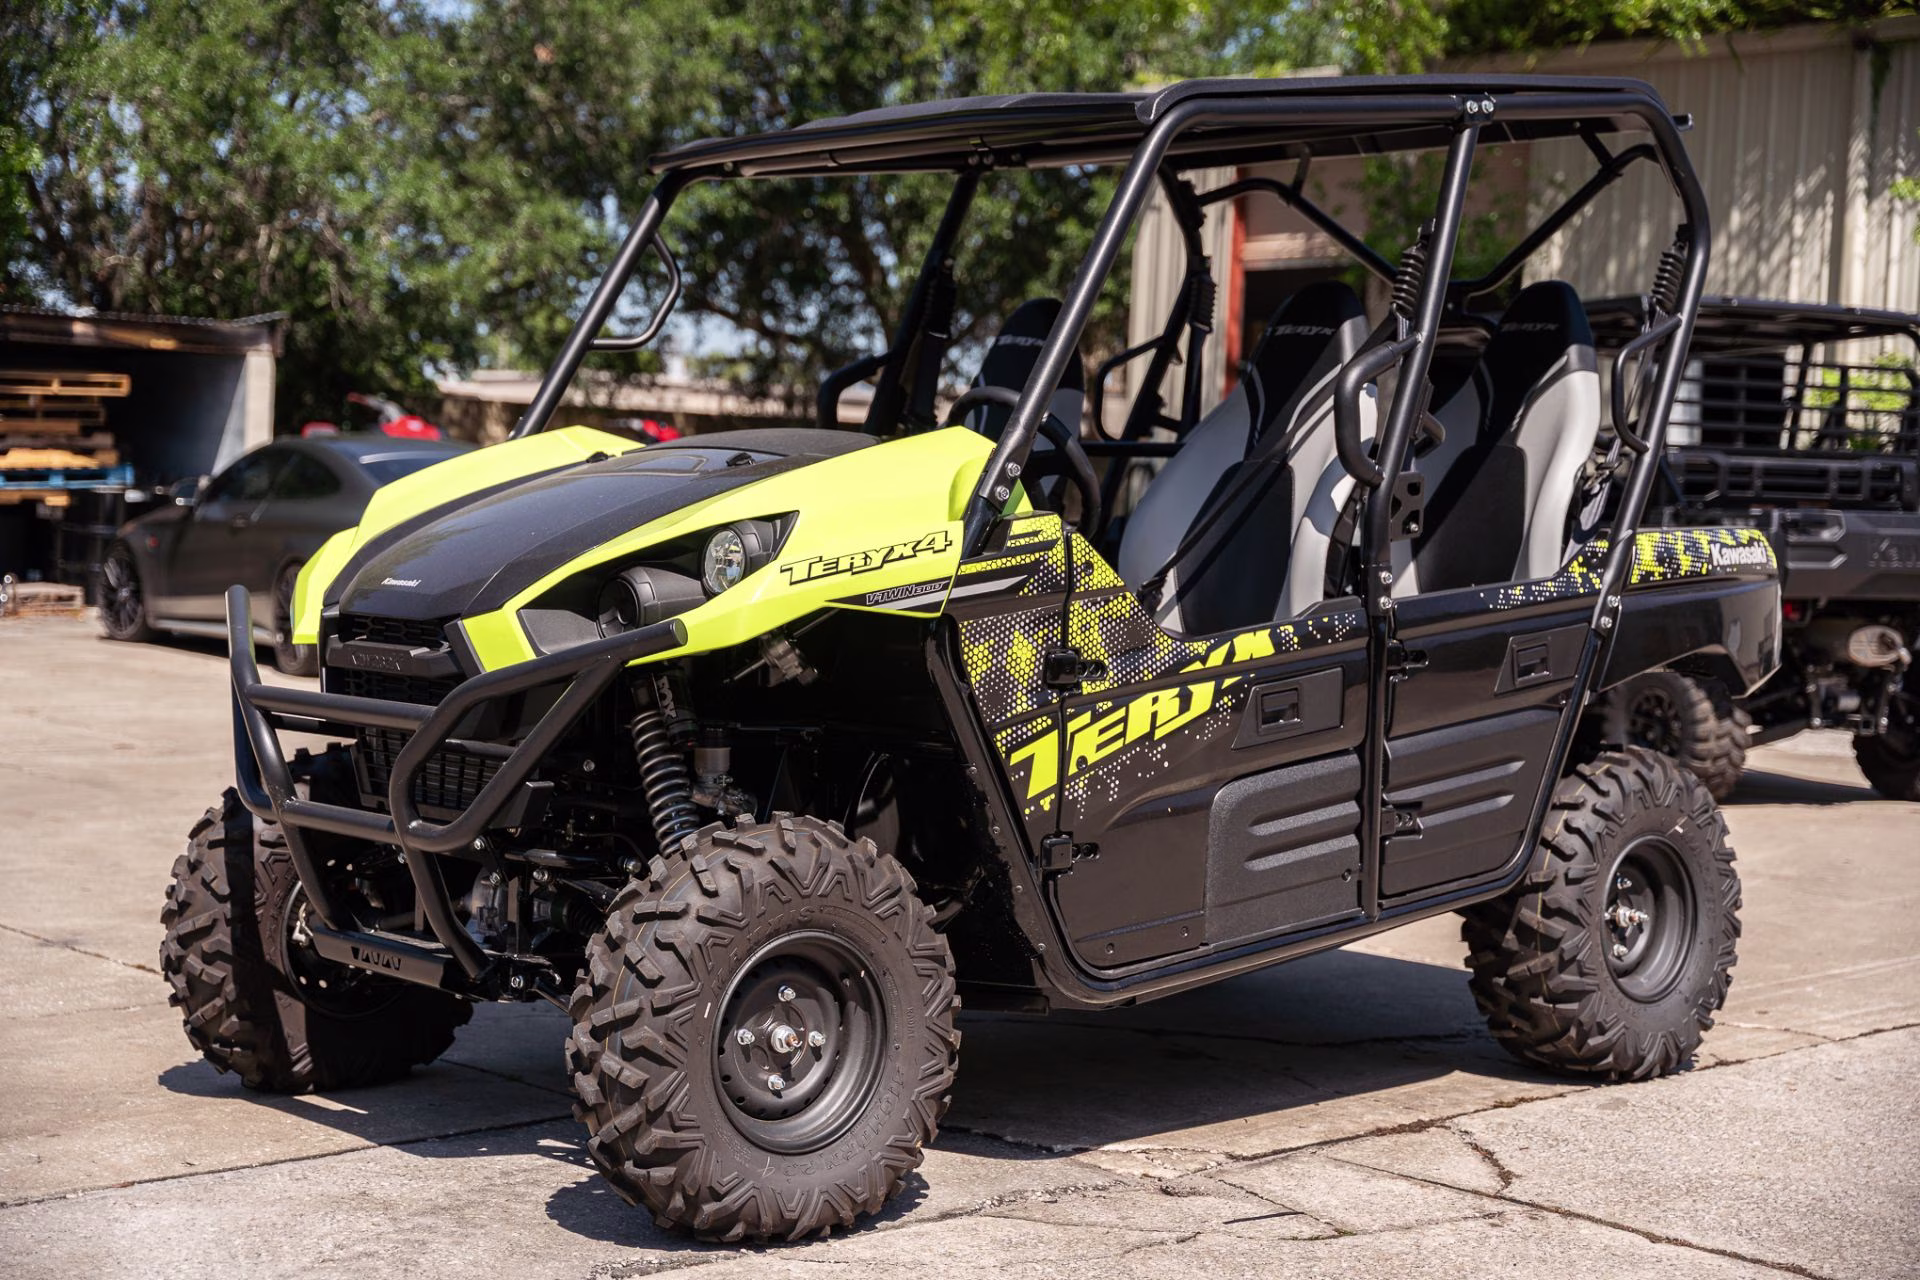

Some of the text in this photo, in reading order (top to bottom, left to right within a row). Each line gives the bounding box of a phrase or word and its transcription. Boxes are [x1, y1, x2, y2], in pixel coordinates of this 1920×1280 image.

[780, 530, 953, 586] TERYX4
[1709, 540, 1768, 567] Kawasaki
[381, 577, 422, 587] Kawasaki
[657, 674, 678, 719] FOX
[1009, 628, 1276, 800] TERYX
